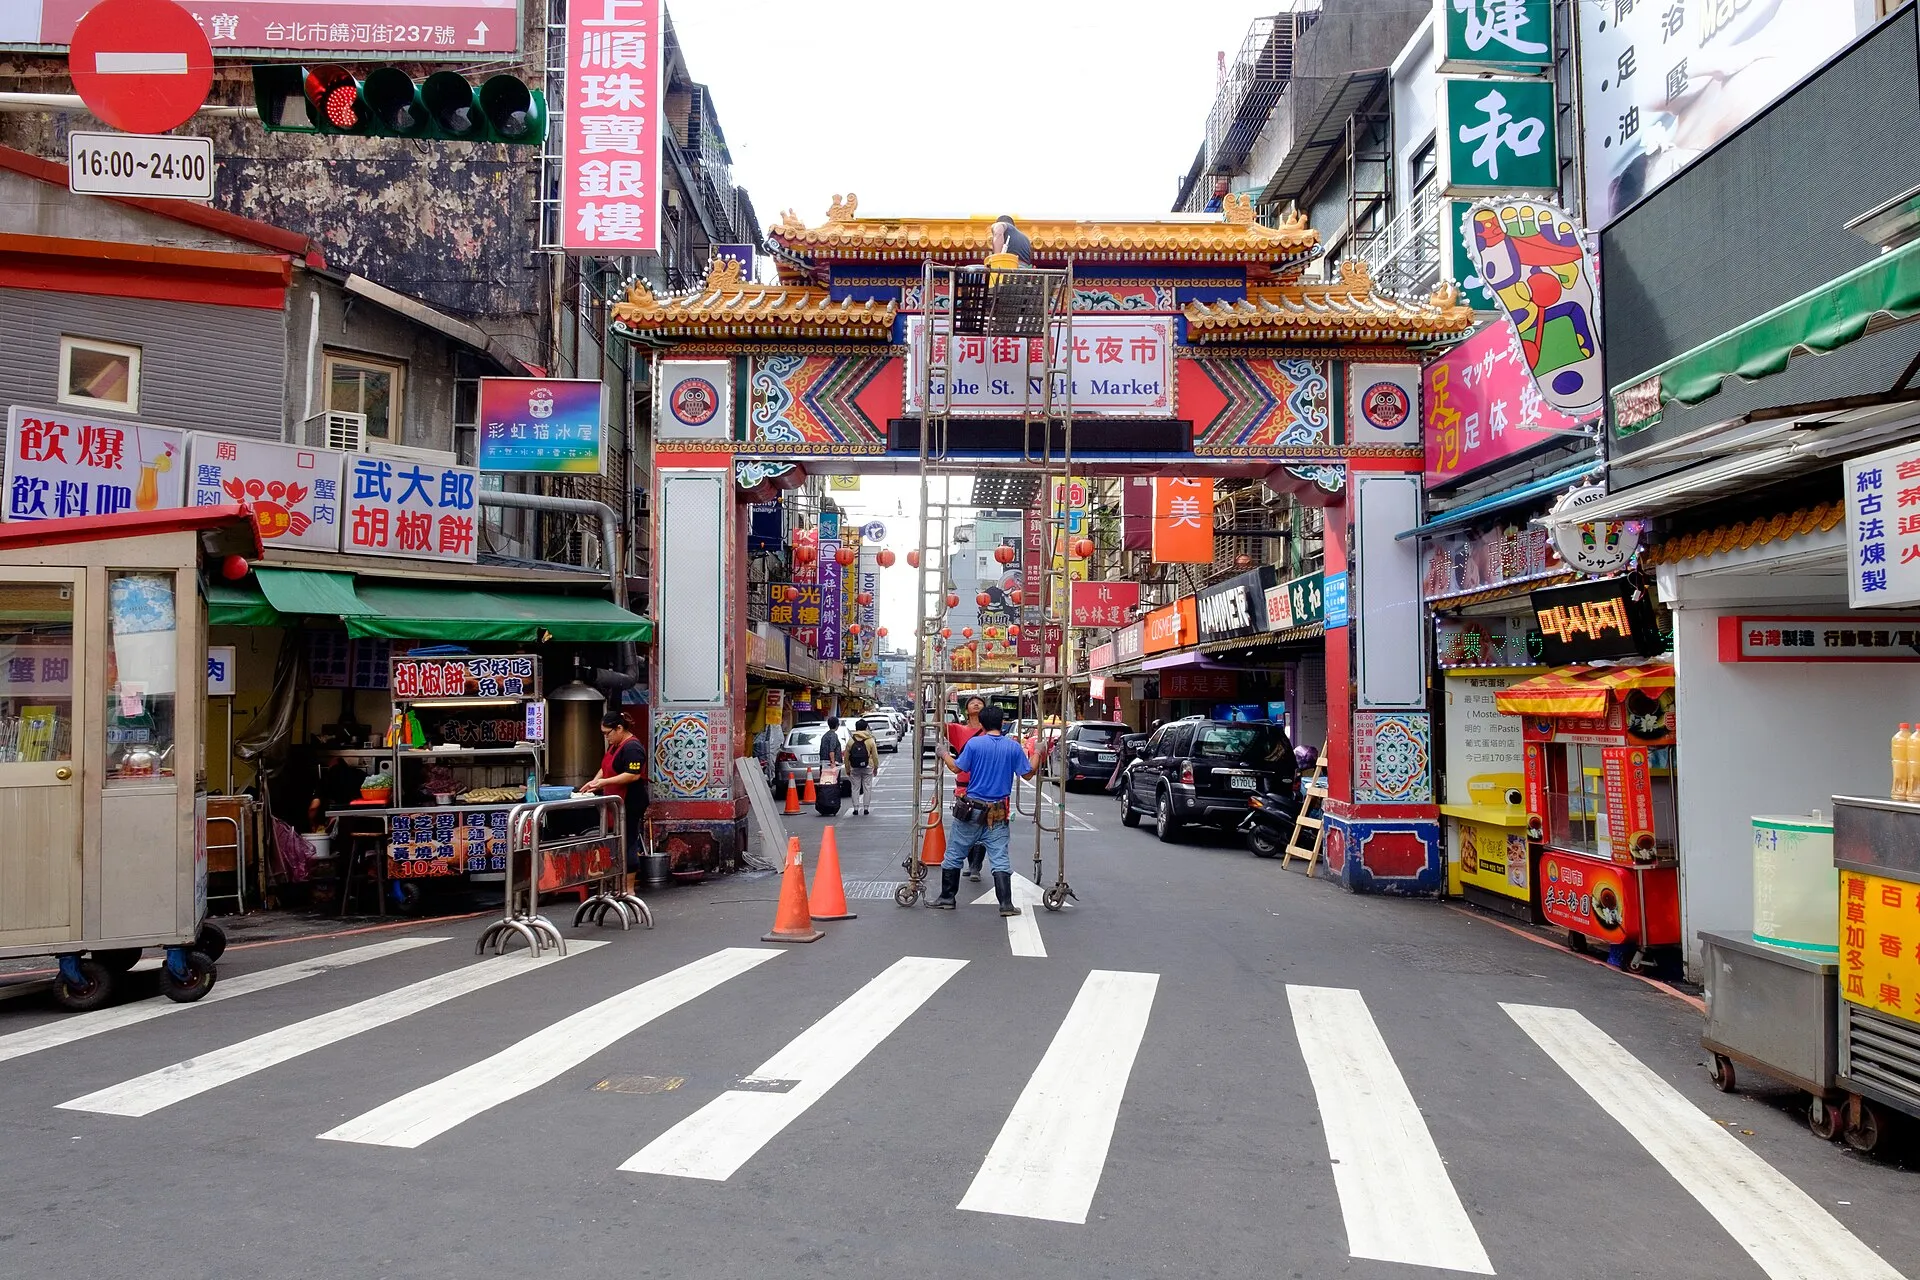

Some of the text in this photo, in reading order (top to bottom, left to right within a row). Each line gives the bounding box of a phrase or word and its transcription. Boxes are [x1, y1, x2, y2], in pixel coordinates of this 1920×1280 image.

[264, 20, 456, 46] 台北市饒河街237號
[577, 0, 647, 242] 上順珠寶銀樓
[77, 148, 205, 181] 16:00~24:00
[991, 379, 1015, 395] St.
[1091, 380, 1160, 396] Market
[20, 418, 125, 470] 飲爆
[488, 422, 593, 440] 彩虹猫冰屋
[11, 475, 131, 518] 飲料吧
[353, 460, 474, 510] 武大郎
[313, 479, 336, 525] 蟹肉
[352, 504, 474, 555] 胡椒餅
[1577, 551, 1625, 568] マッサージ
[770, 605, 820, 625] 銀樓
[1198, 585, 1251, 635] HAMMER
[1749, 629, 1815, 647] 台灣製造
[396, 662, 466, 696] 胡椒餅
[468, 658, 532, 677] 不好吃
[479, 678, 523, 697] 免費
[401, 860, 449, 875] 10元
[1879, 884, 1903, 1010] 百香果
